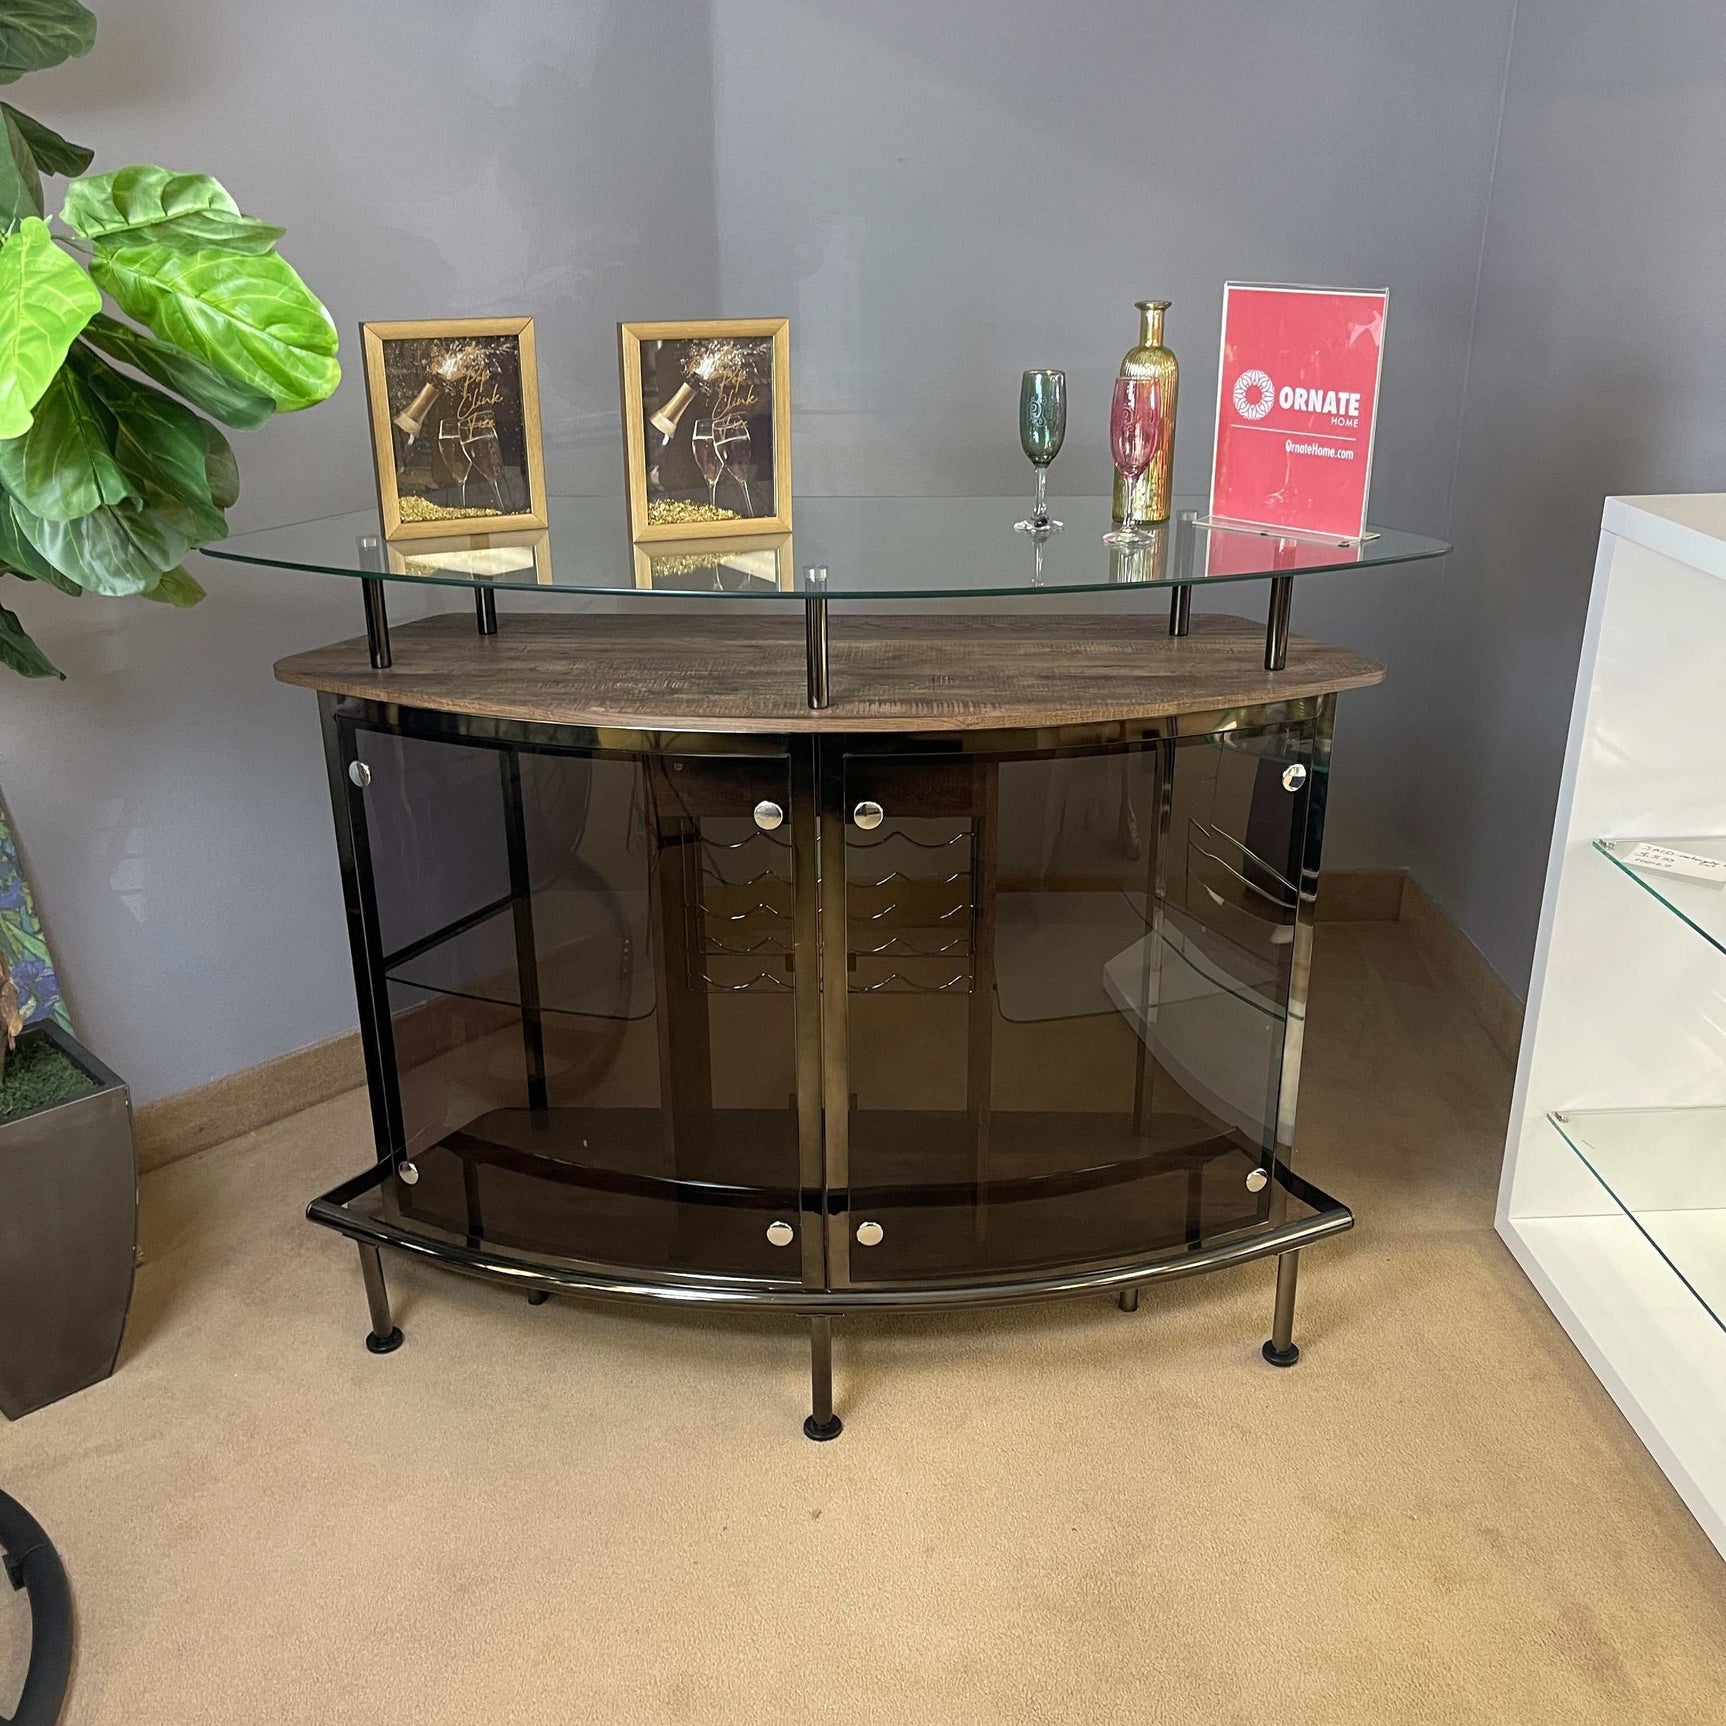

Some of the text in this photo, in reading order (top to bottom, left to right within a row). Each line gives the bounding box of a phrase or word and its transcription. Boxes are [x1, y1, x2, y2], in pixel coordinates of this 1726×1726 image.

[463, 367, 490, 396] Pop
[457, 383, 504, 420] Clink
[711, 383, 758, 420] Clink
[1279, 386, 1361, 416] ORNATE
[1331, 416, 1358, 428] HOME
[1285, 439, 1354, 460] OrnateHome.com
